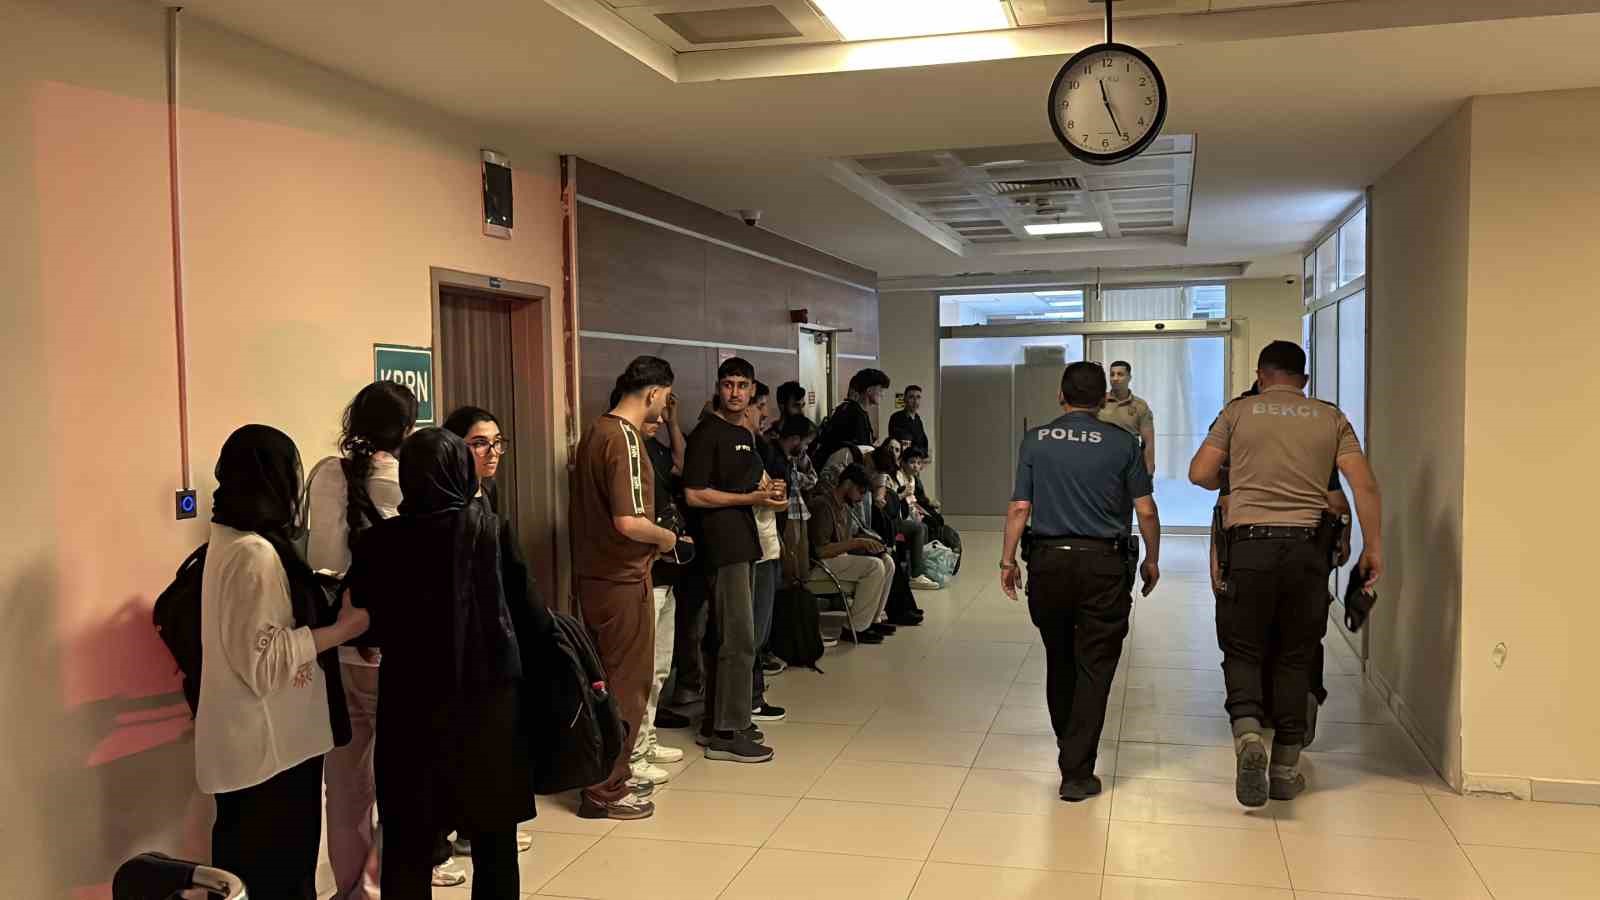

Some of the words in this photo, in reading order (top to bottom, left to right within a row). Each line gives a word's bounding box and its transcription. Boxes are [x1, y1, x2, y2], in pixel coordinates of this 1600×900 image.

[1102, 58, 1113, 68] 12
[1084, 65, 1092, 75] 11
[1069, 81, 1080, 90] 10
[1139, 77, 1147, 87] 2
[1063, 100, 1069, 110] 9
[1144, 96, 1152, 106] 3
[1067, 120, 1074, 129] 8
[1137, 116, 1145, 127] 4
[1082, 134, 1089, 143] 7
[1121, 132, 1129, 142] 5
[1101, 138, 1110, 147] 6
